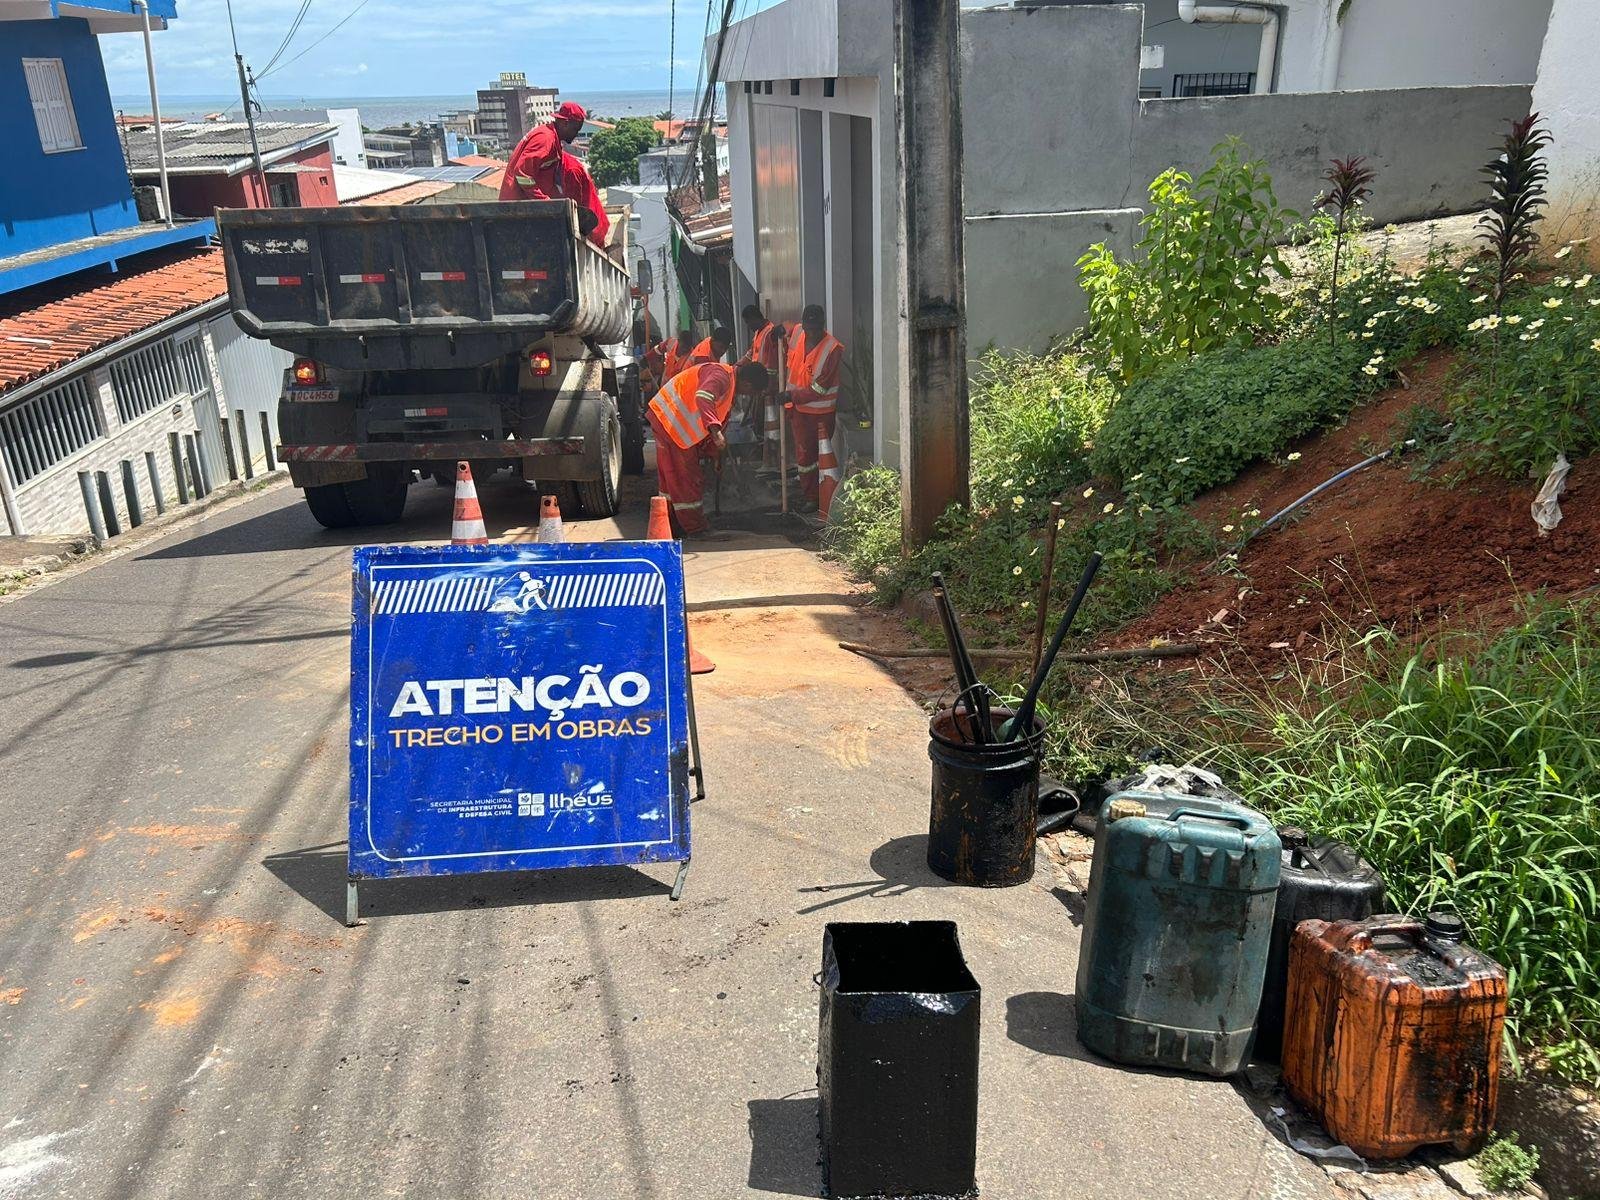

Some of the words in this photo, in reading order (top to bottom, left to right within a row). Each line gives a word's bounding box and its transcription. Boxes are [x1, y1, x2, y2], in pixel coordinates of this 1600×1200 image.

[389, 664, 651, 721] ATENÇÃO
[389, 725, 503, 748] TRECHO
[511, 723, 551, 742] EM
[557, 717, 652, 740] OBRAS
[430, 800, 474, 808] SECRETARIA
[474, 797, 512, 805] MUNICIPAL
[448, 804, 513, 812] INFRAESTRUTURA
[549, 791, 613, 808] Ilhéus
